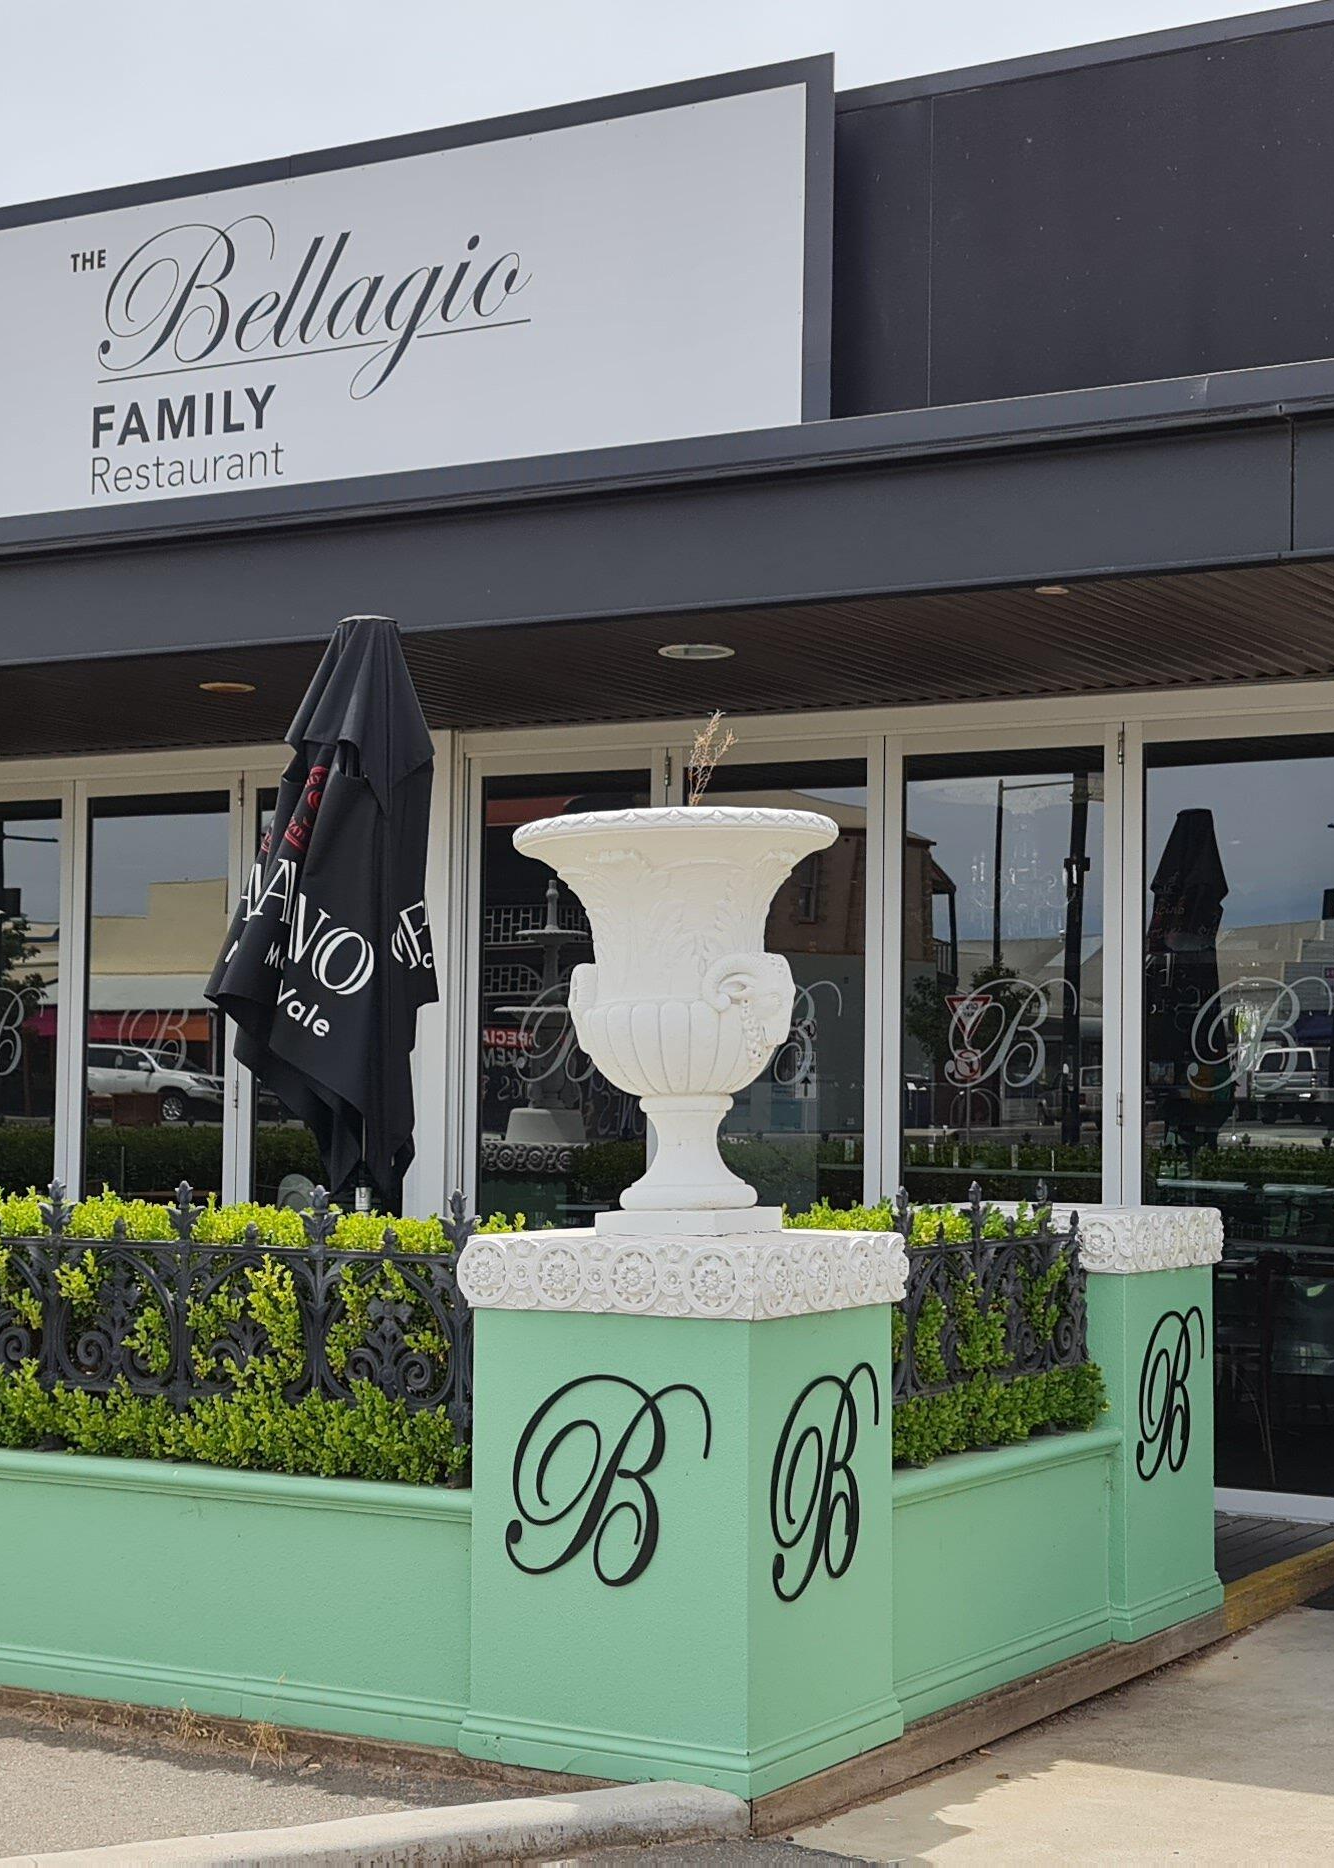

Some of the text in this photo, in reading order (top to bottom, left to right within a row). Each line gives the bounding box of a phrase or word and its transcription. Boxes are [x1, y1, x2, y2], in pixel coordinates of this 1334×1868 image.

[70, 215, 532, 400] THE Bellagio
[91, 442, 284, 495] Restaurant
[92, 384, 276, 449] FAMILY
[277, 979, 330, 1037] Vale
[505, 1374, 711, 1587] B
[770, 1361, 879, 1602] B
[1136, 1305, 1205, 1482] B
